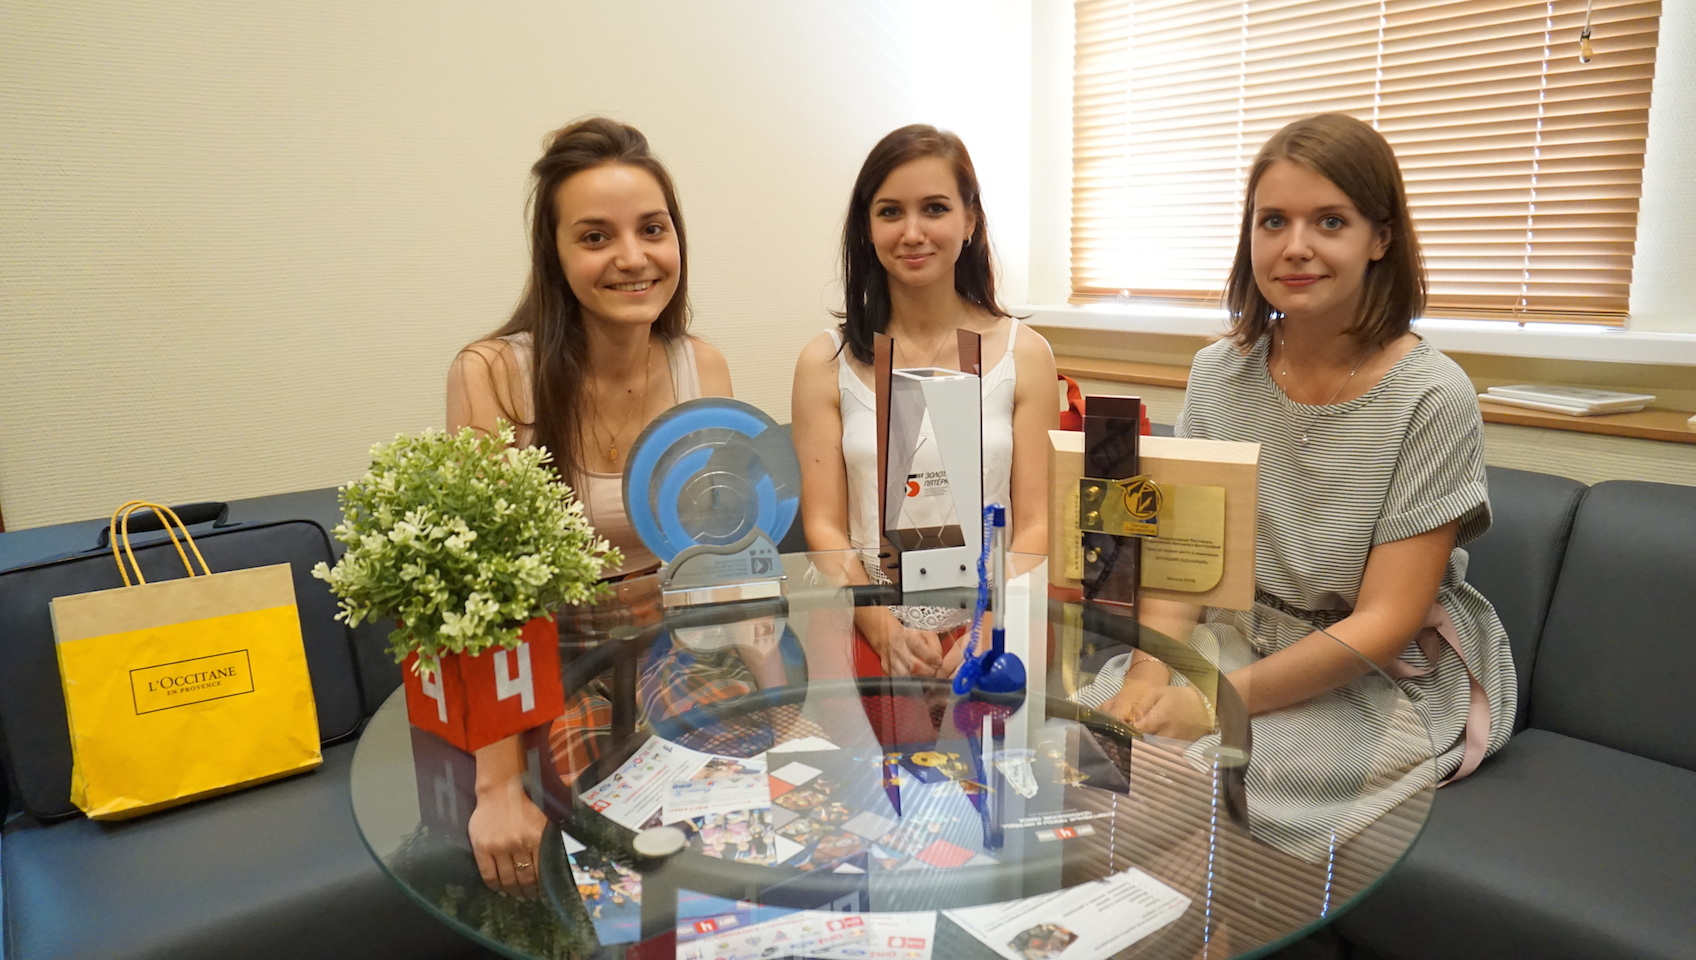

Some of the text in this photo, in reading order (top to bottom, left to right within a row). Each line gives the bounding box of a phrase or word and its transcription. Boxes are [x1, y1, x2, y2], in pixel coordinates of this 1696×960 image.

[148, 667, 237, 692] L'OCCITANE
[167, 680, 222, 696] EN PROVENCE
